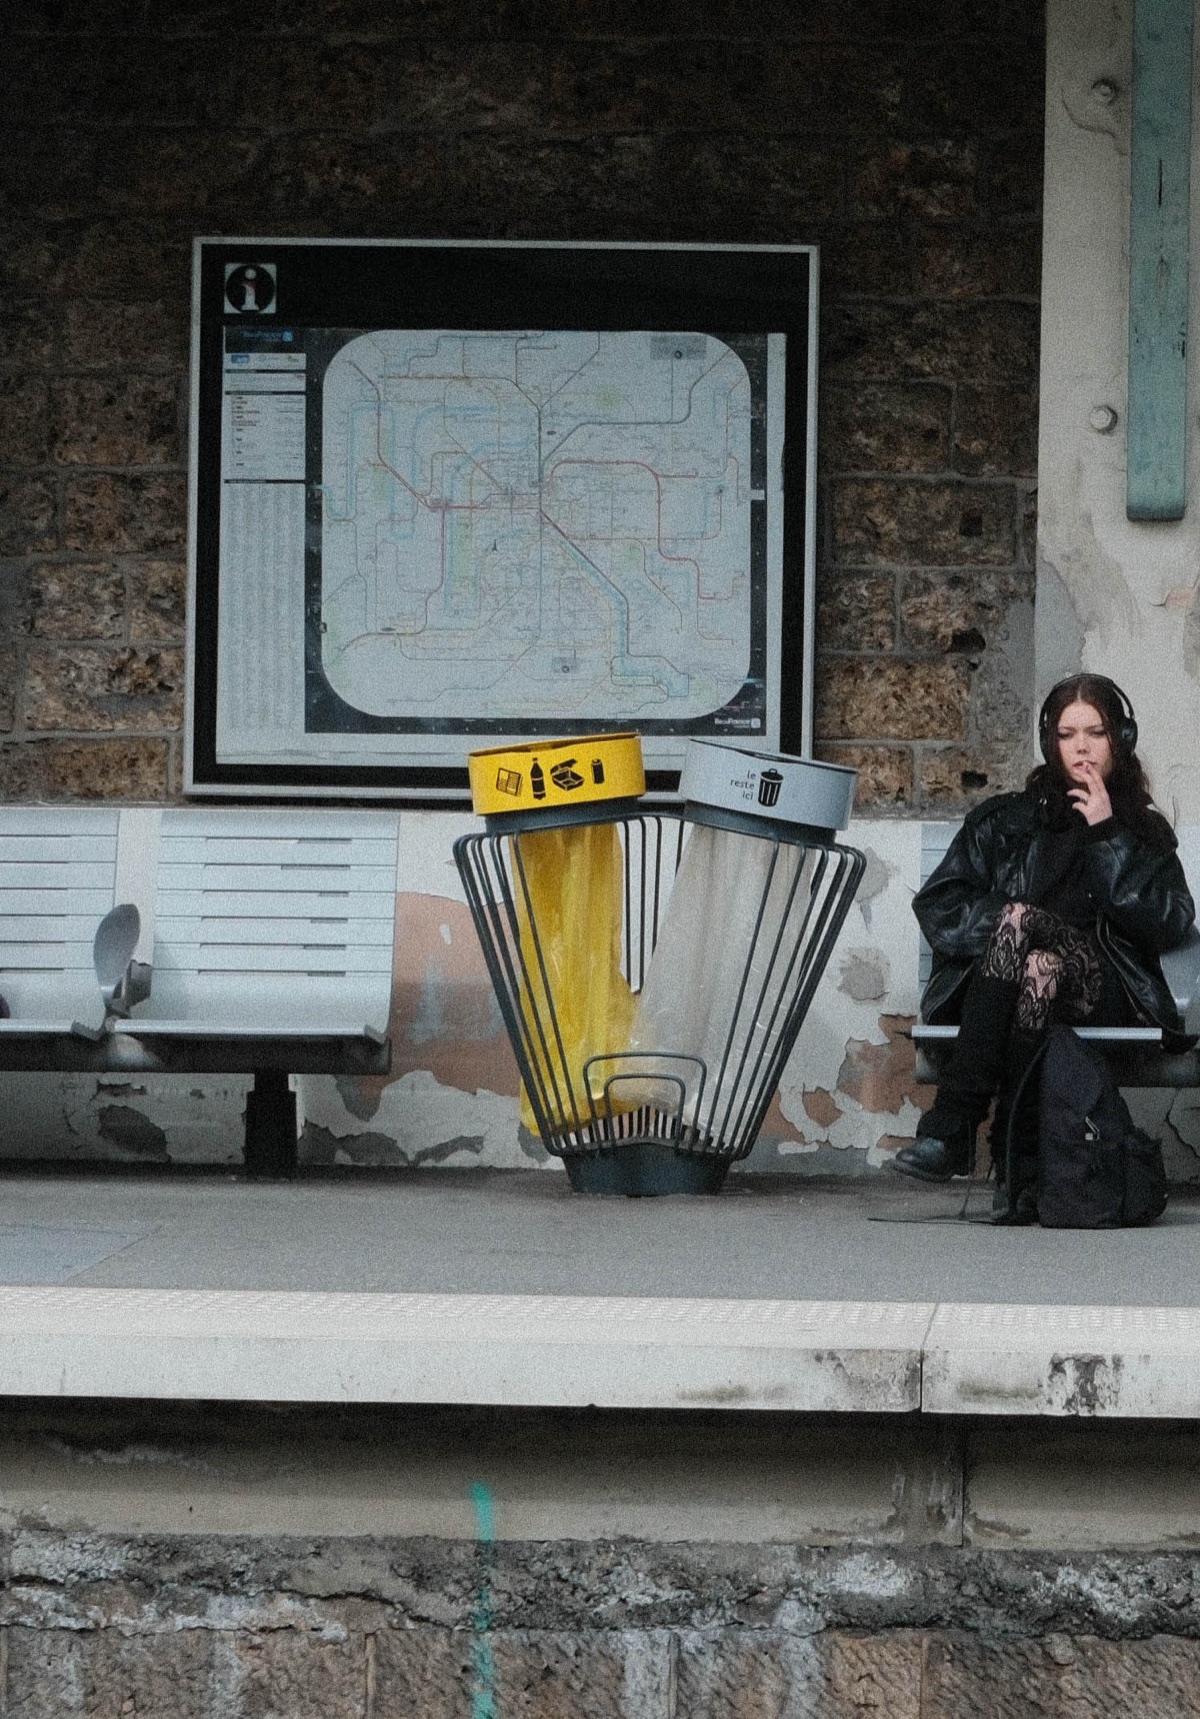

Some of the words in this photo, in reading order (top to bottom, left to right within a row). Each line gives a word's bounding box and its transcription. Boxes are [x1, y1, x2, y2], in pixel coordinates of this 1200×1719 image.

[747, 770, 756, 779] le
[730, 779, 755, 789] reste
[742, 790, 754, 801] ici
